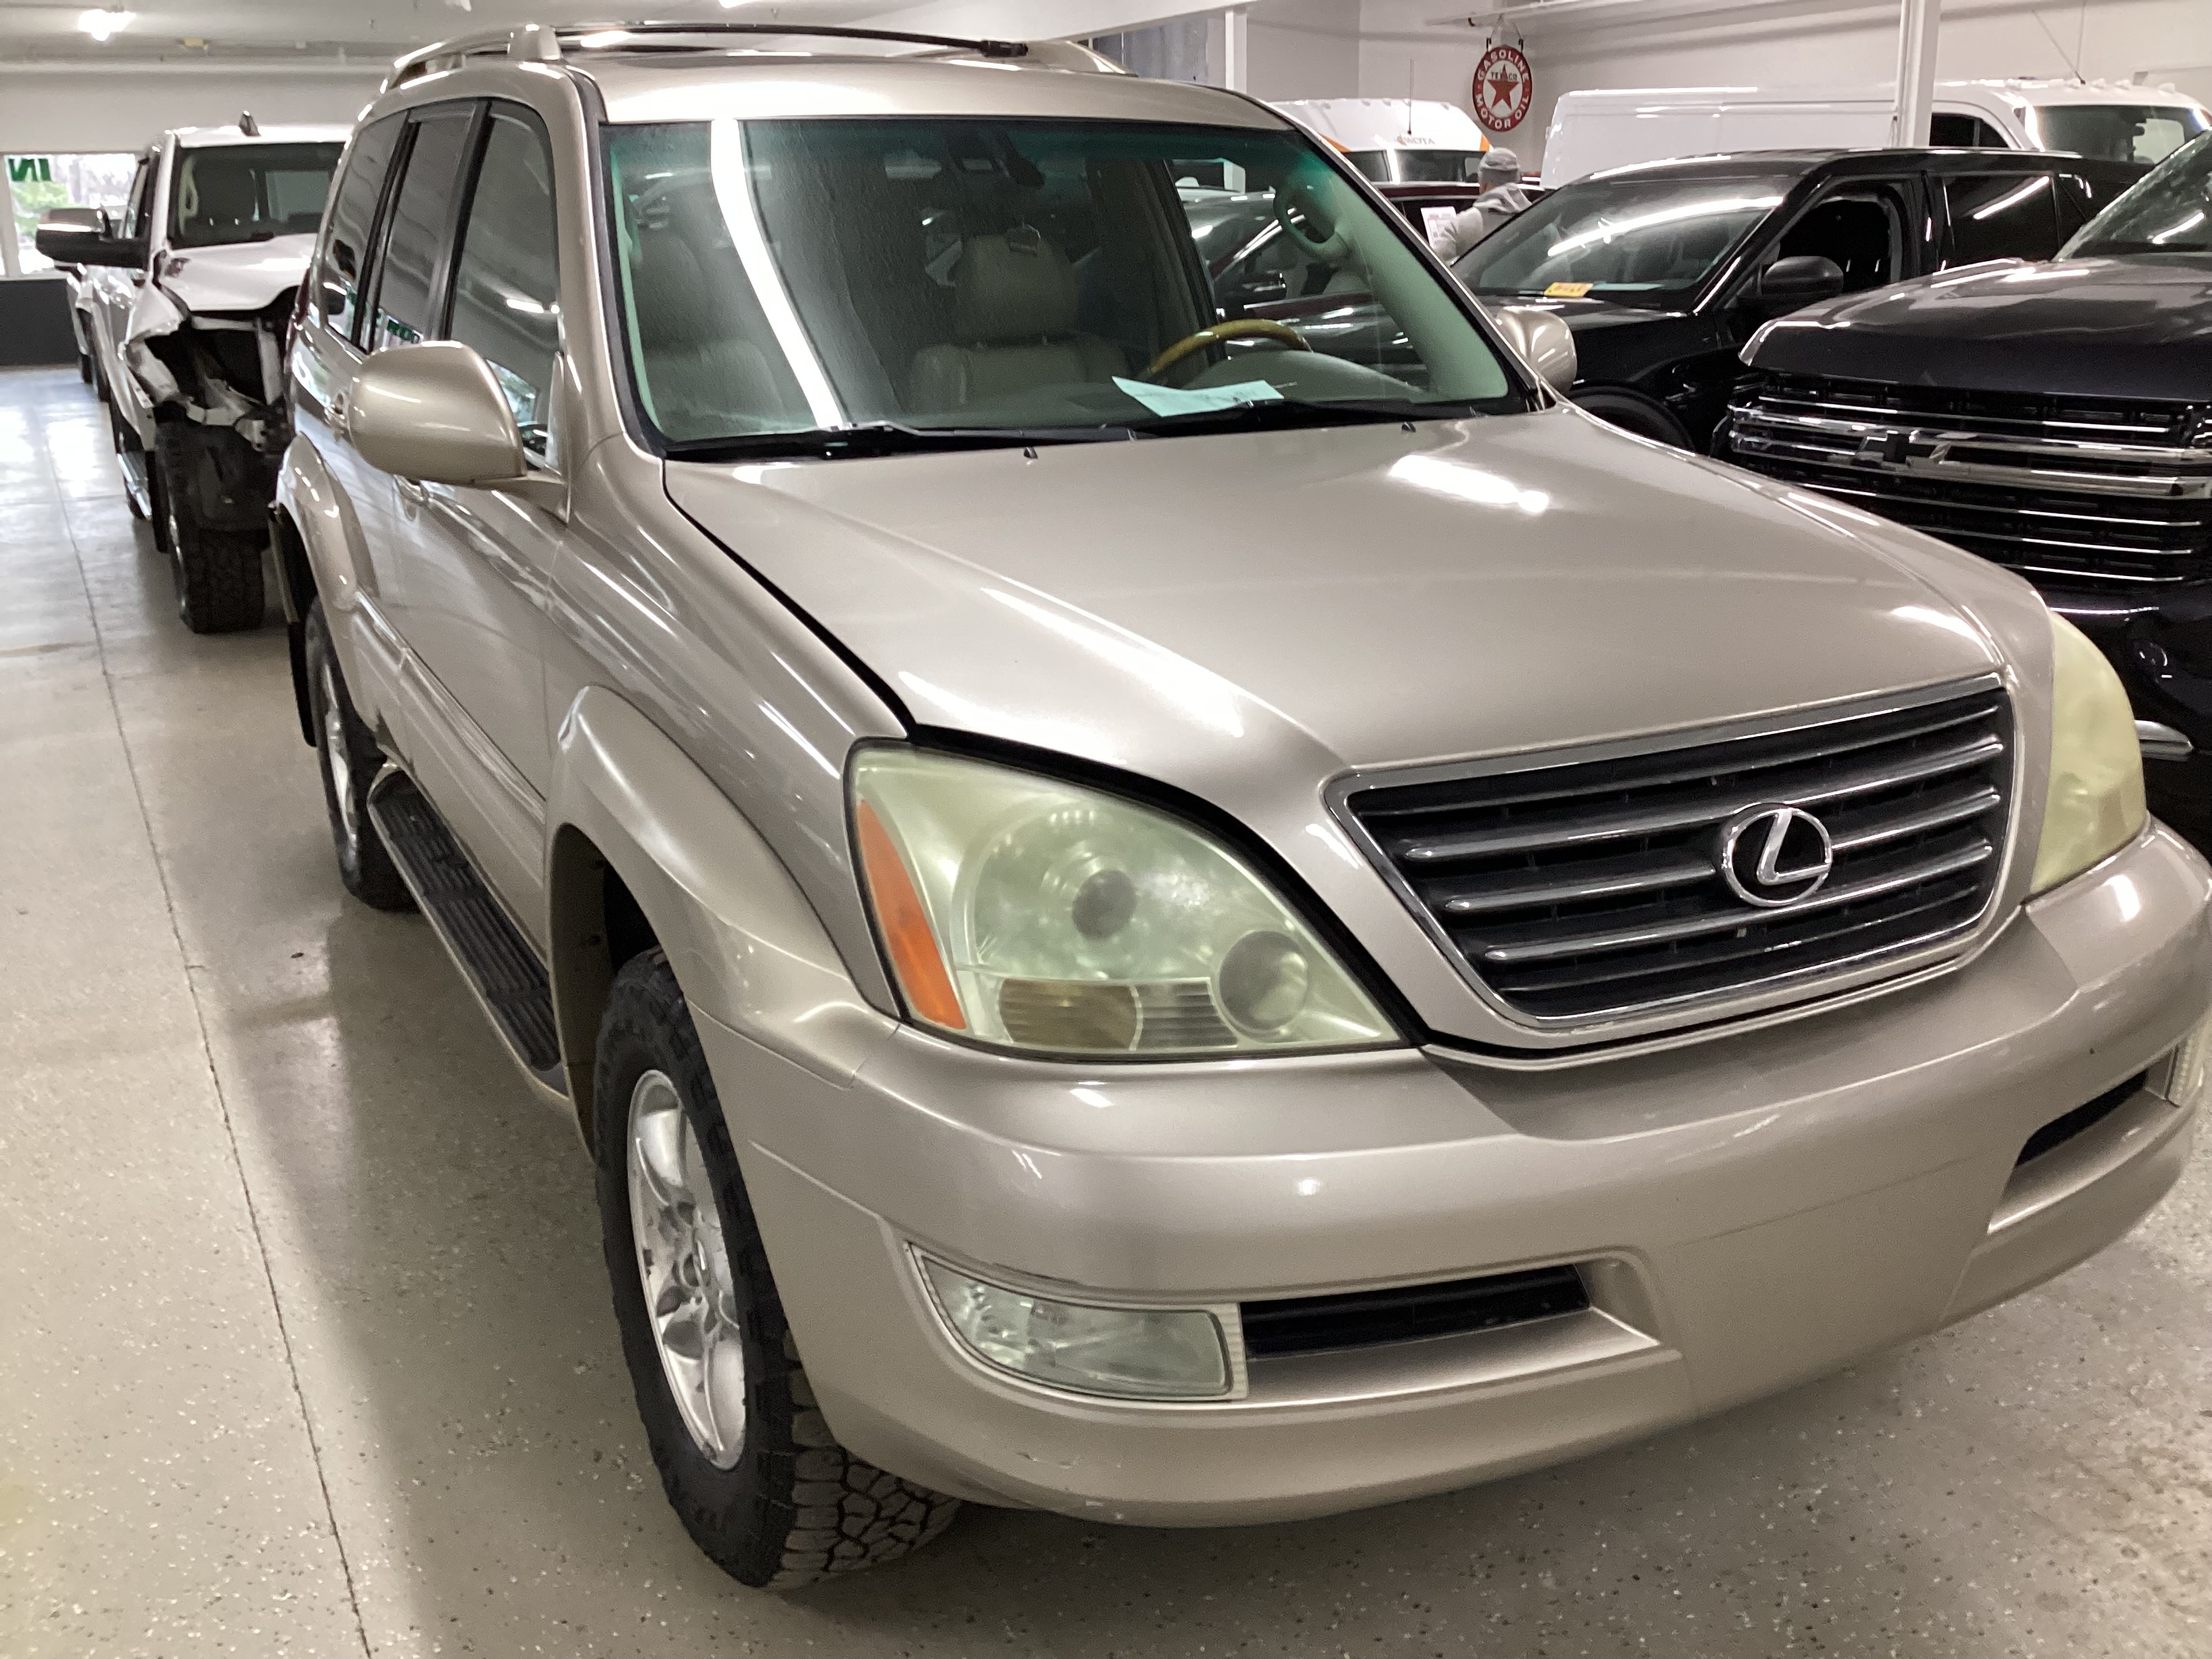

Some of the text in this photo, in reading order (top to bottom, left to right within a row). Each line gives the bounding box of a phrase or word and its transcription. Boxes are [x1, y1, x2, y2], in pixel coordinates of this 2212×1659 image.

[1477, 49, 1530, 83] GASOLINE
[1491, 72, 1517, 81] TECO
[1475, 94, 1530, 129] MOTOR OIL
